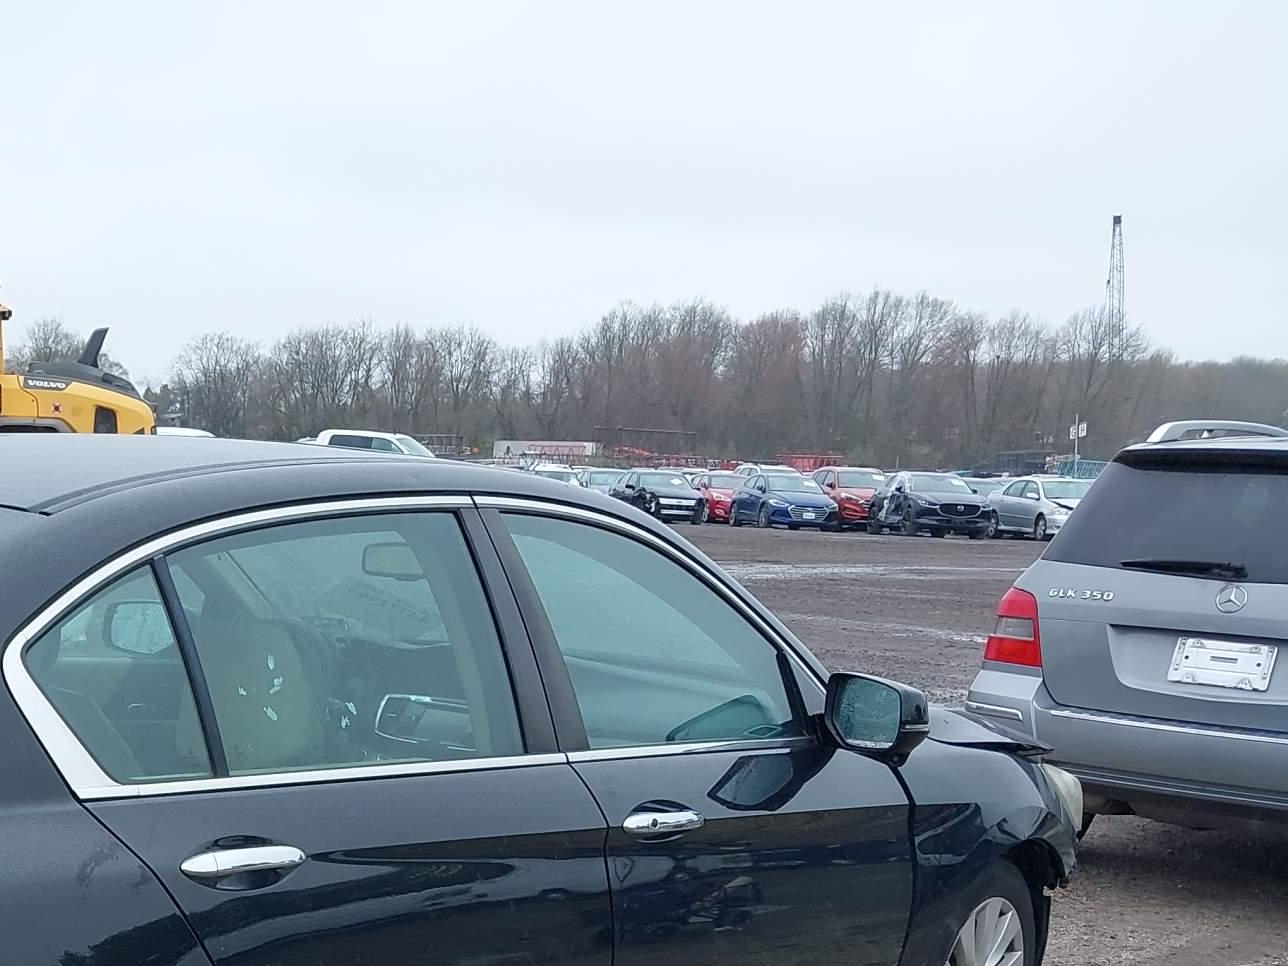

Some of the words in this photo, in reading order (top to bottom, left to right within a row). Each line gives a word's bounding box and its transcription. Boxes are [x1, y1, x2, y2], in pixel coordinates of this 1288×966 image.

[27, 380, 66, 388] VOLVO
[1049, 588, 1077, 598] GLK
[1080, 590, 1114, 601] 350
